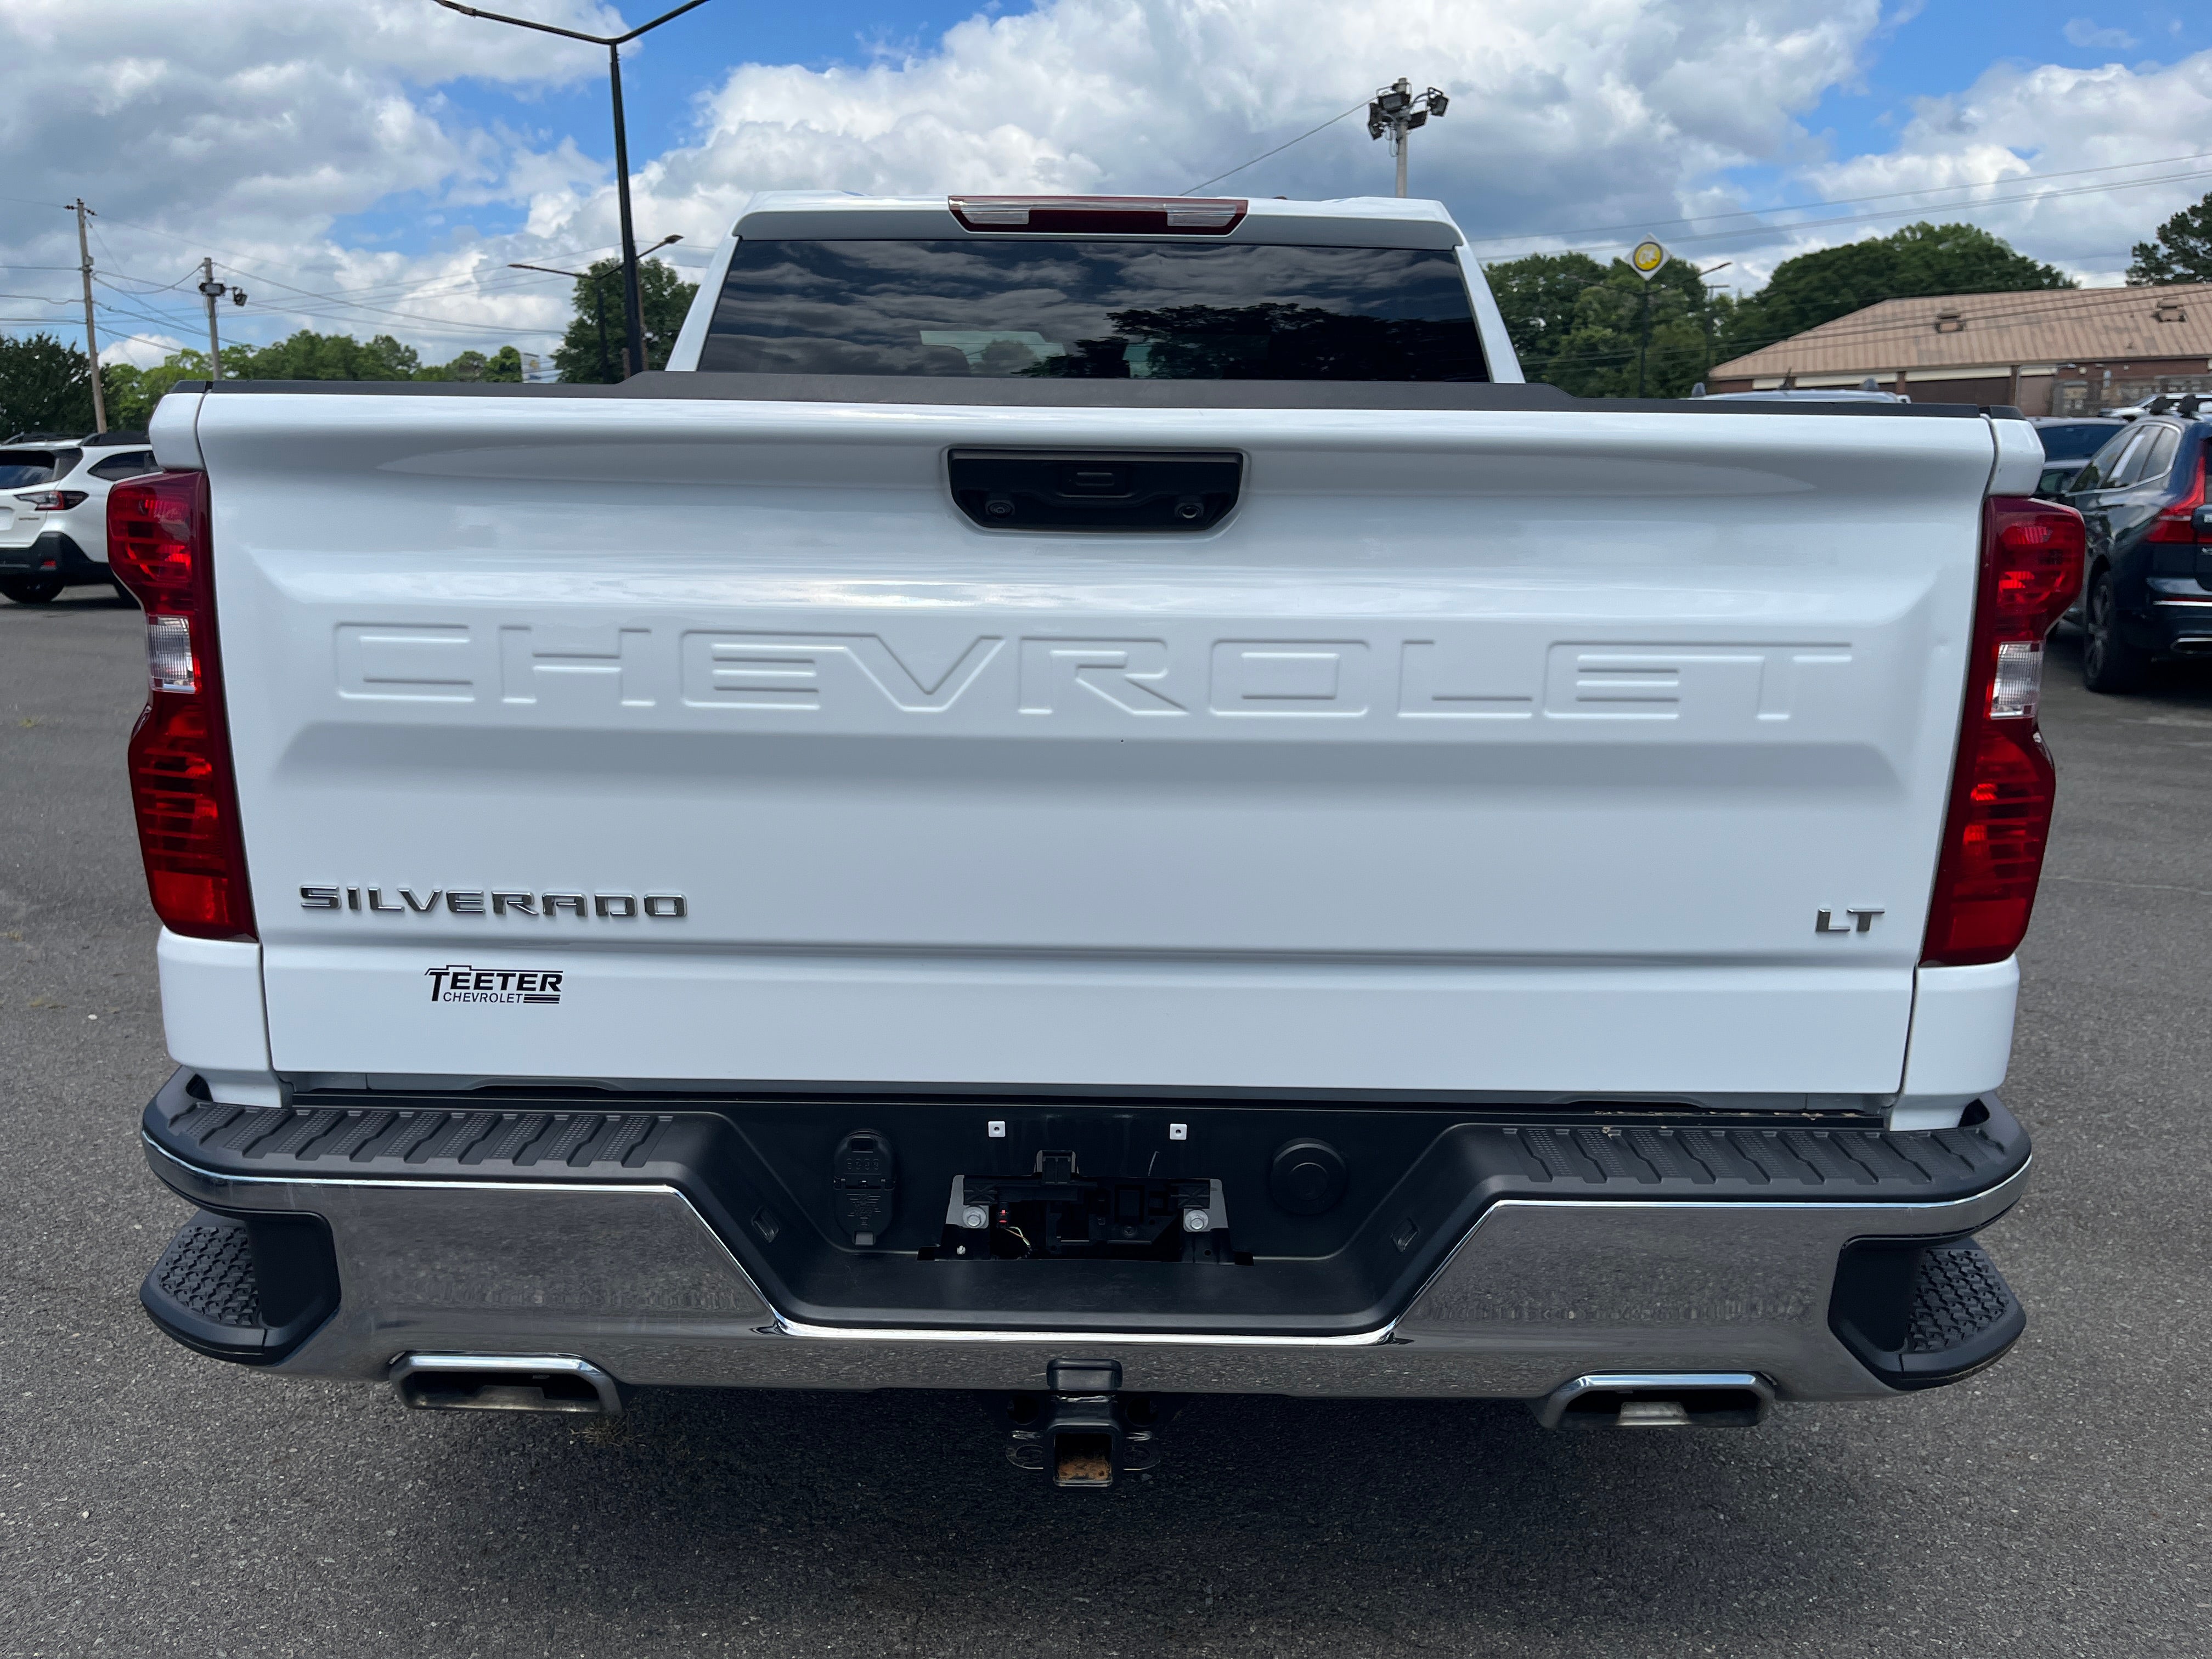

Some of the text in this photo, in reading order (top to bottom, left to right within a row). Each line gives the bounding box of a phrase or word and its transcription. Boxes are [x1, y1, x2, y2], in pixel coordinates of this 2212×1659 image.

[332, 621, 1853, 721] CHEVROLET
[300, 885, 688, 918] SILVERADO
[1815, 908, 1885, 932] LT
[428, 970, 563, 1002] TEETER
[443, 992, 523, 1004] CHEVROLET
